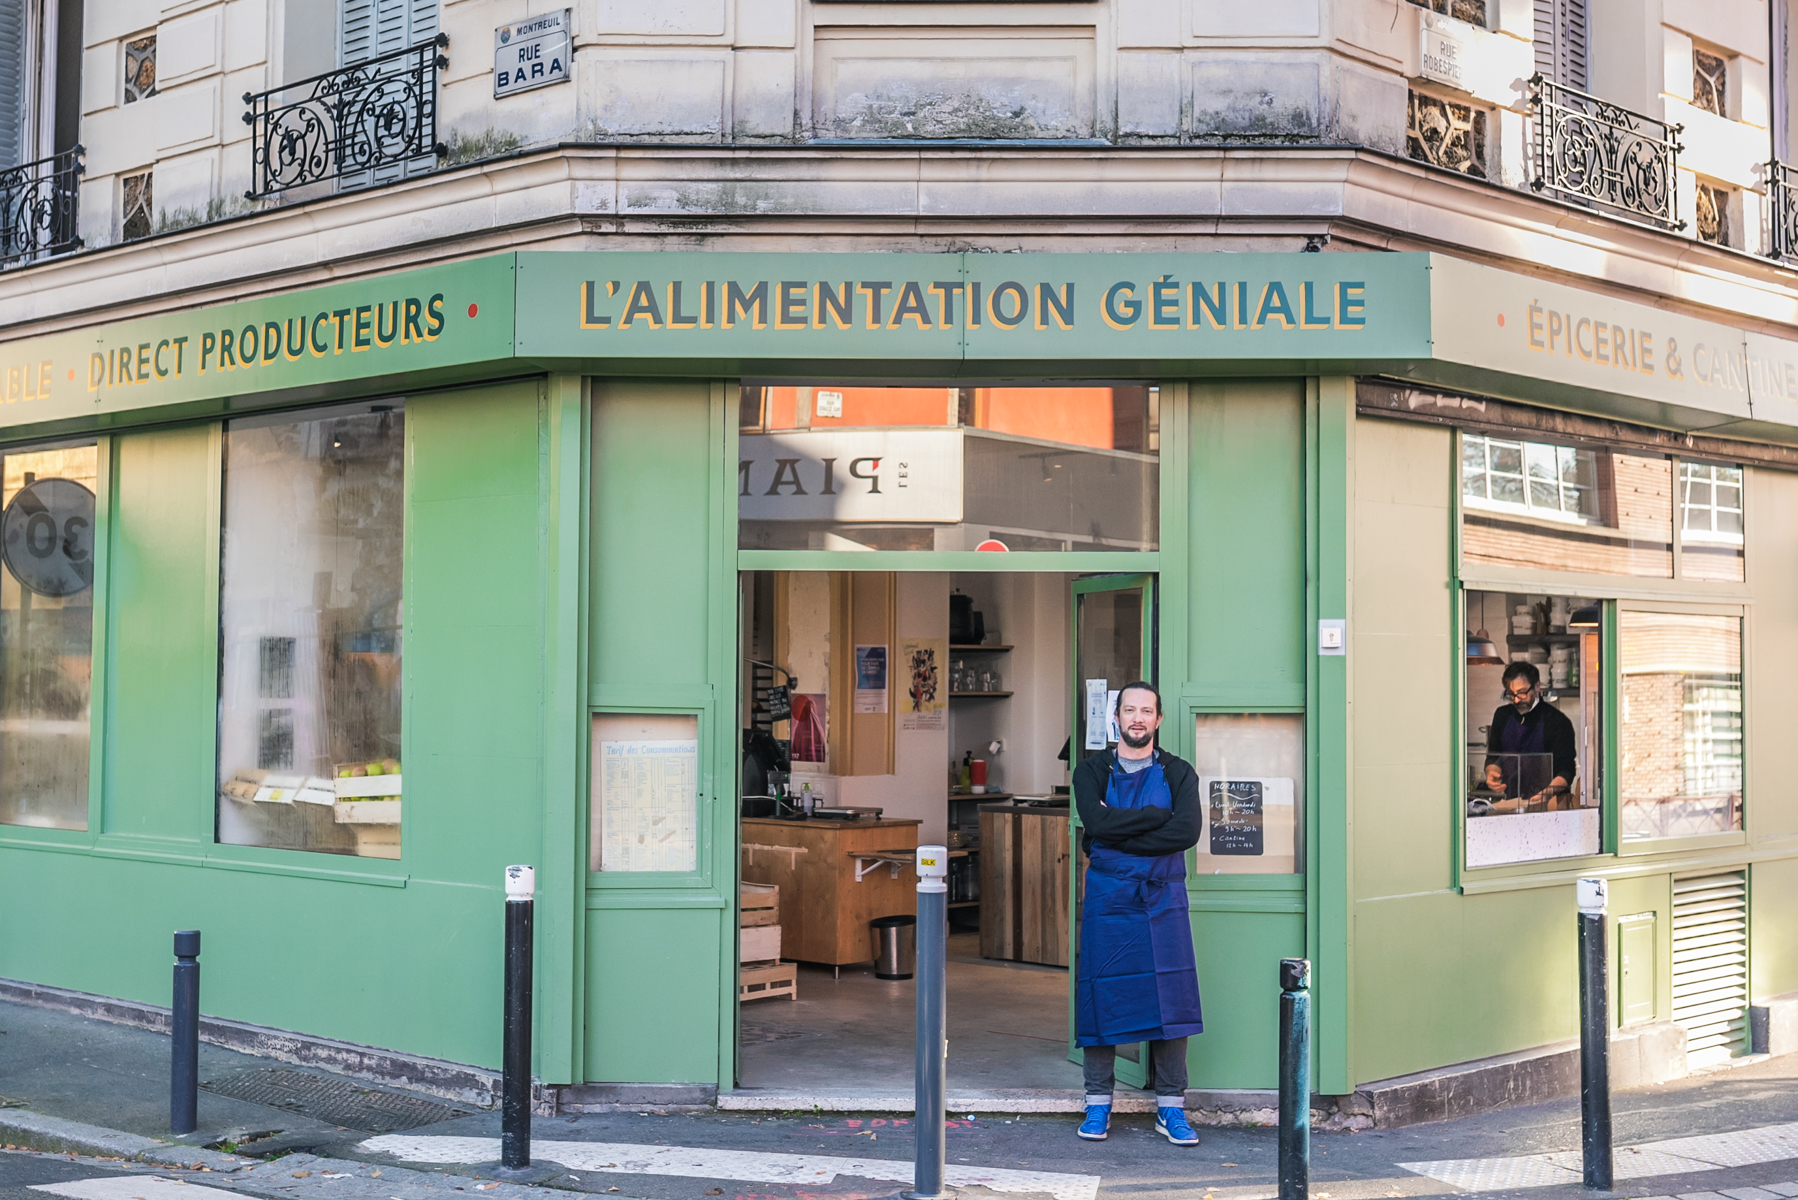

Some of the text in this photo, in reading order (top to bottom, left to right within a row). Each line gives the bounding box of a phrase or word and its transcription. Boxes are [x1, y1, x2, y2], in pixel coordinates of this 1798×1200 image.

[516, 16, 561, 37] MONTREUIL
[518, 43, 541, 64] RUE
[1440, 41, 1457, 60] RUE
[497, 58, 563, 88] BARA
[579, 273, 1367, 331] L'ALIMENTATION GÉNIALE
[87, 335, 189, 393] DIRECT
[199, 292, 446, 377] PRODUCTEURS
[1526, 299, 1798, 403] ÉPICERIE & CANTINE
[627, 745, 639, 755] des
[1214, 782, 1257, 791] HORAIRES
